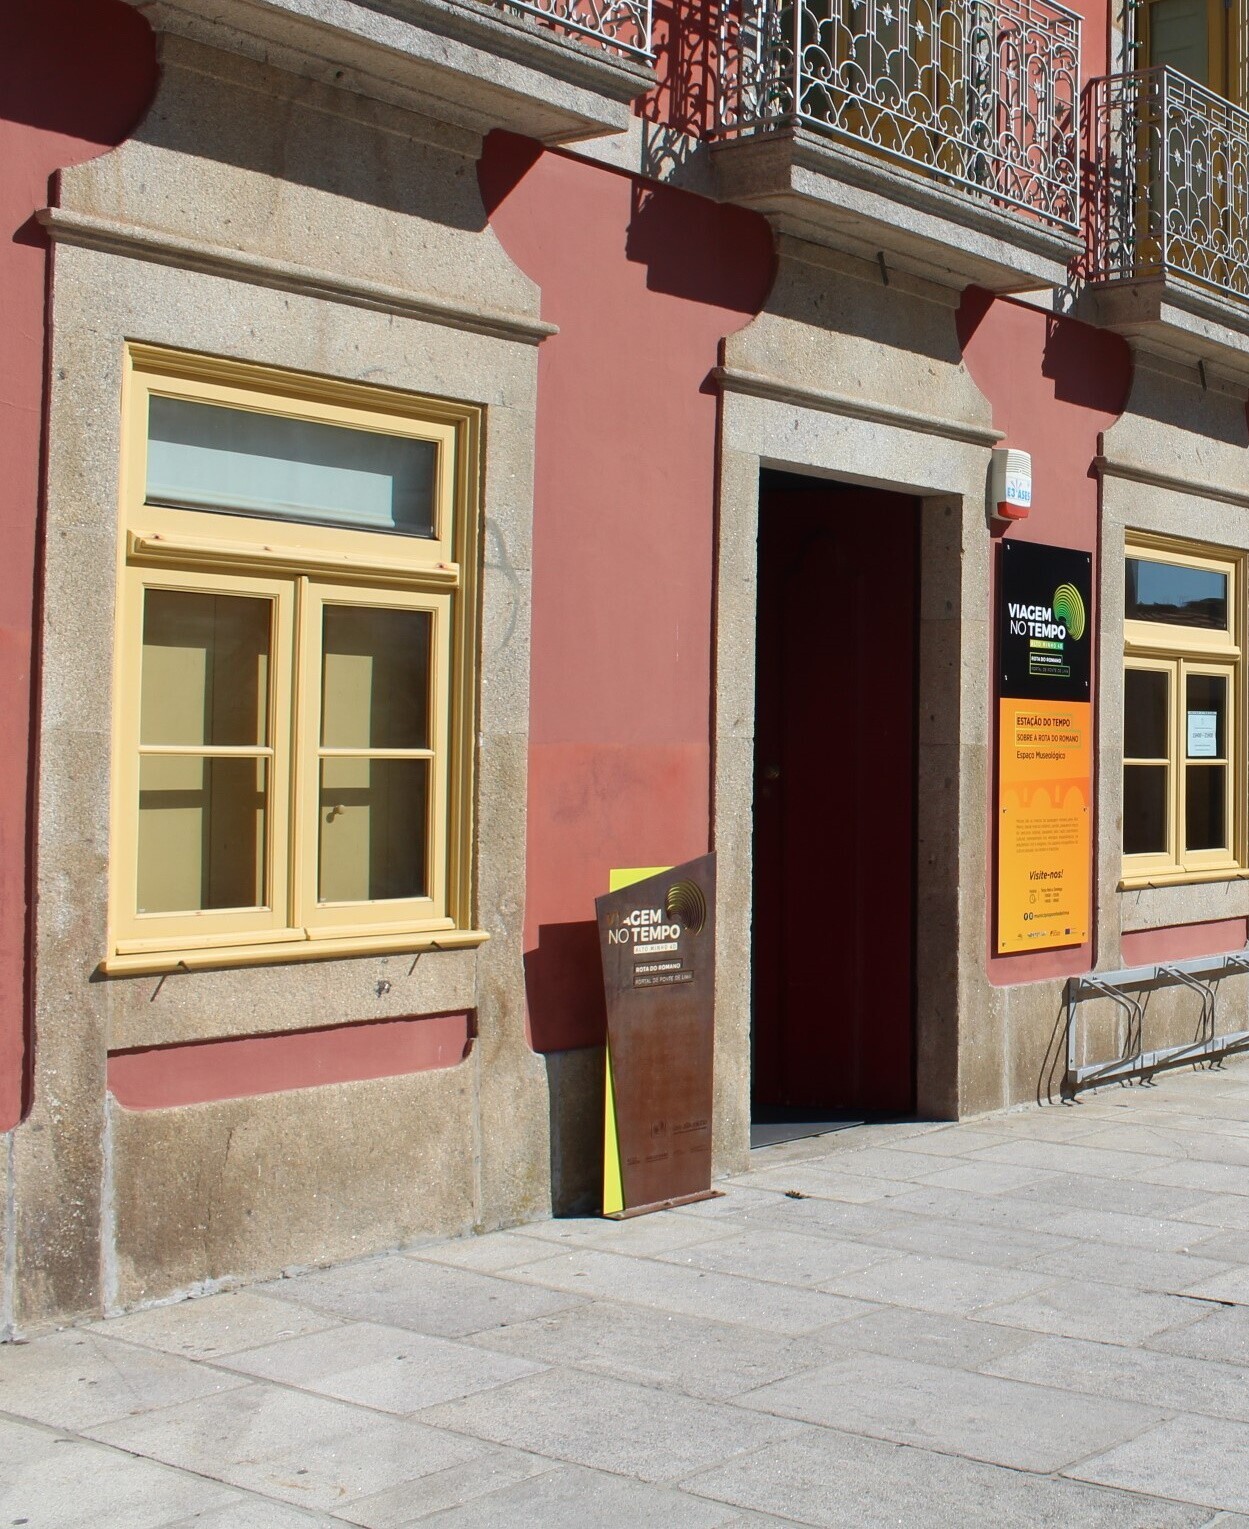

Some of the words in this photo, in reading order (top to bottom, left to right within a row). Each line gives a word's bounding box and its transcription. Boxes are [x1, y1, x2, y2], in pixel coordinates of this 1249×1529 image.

[1008, 602, 1052, 622] VIAGEM
[1010, 619, 1027, 636] NO
[1028, 621, 1066, 640] TEMPO
[1016, 715, 1042, 727] ESTAÇÃO
[1043, 718, 1051, 726] DO
[1052, 718, 1071, 727] TEMPO
[1017, 733, 1032, 742] SOBRE
[1038, 734, 1050, 742] ROTA
[1059, 735, 1079, 743] ROMANO
[1016, 751, 1035, 760] Espaço
[1035, 751, 1066, 761] Museológico
[1029, 869, 1064, 880] Visite-nos!
[608, 928, 630, 945] NO
[631, 924, 681, 943] TEMPO
[658, 962, 681, 971] ROMANO
